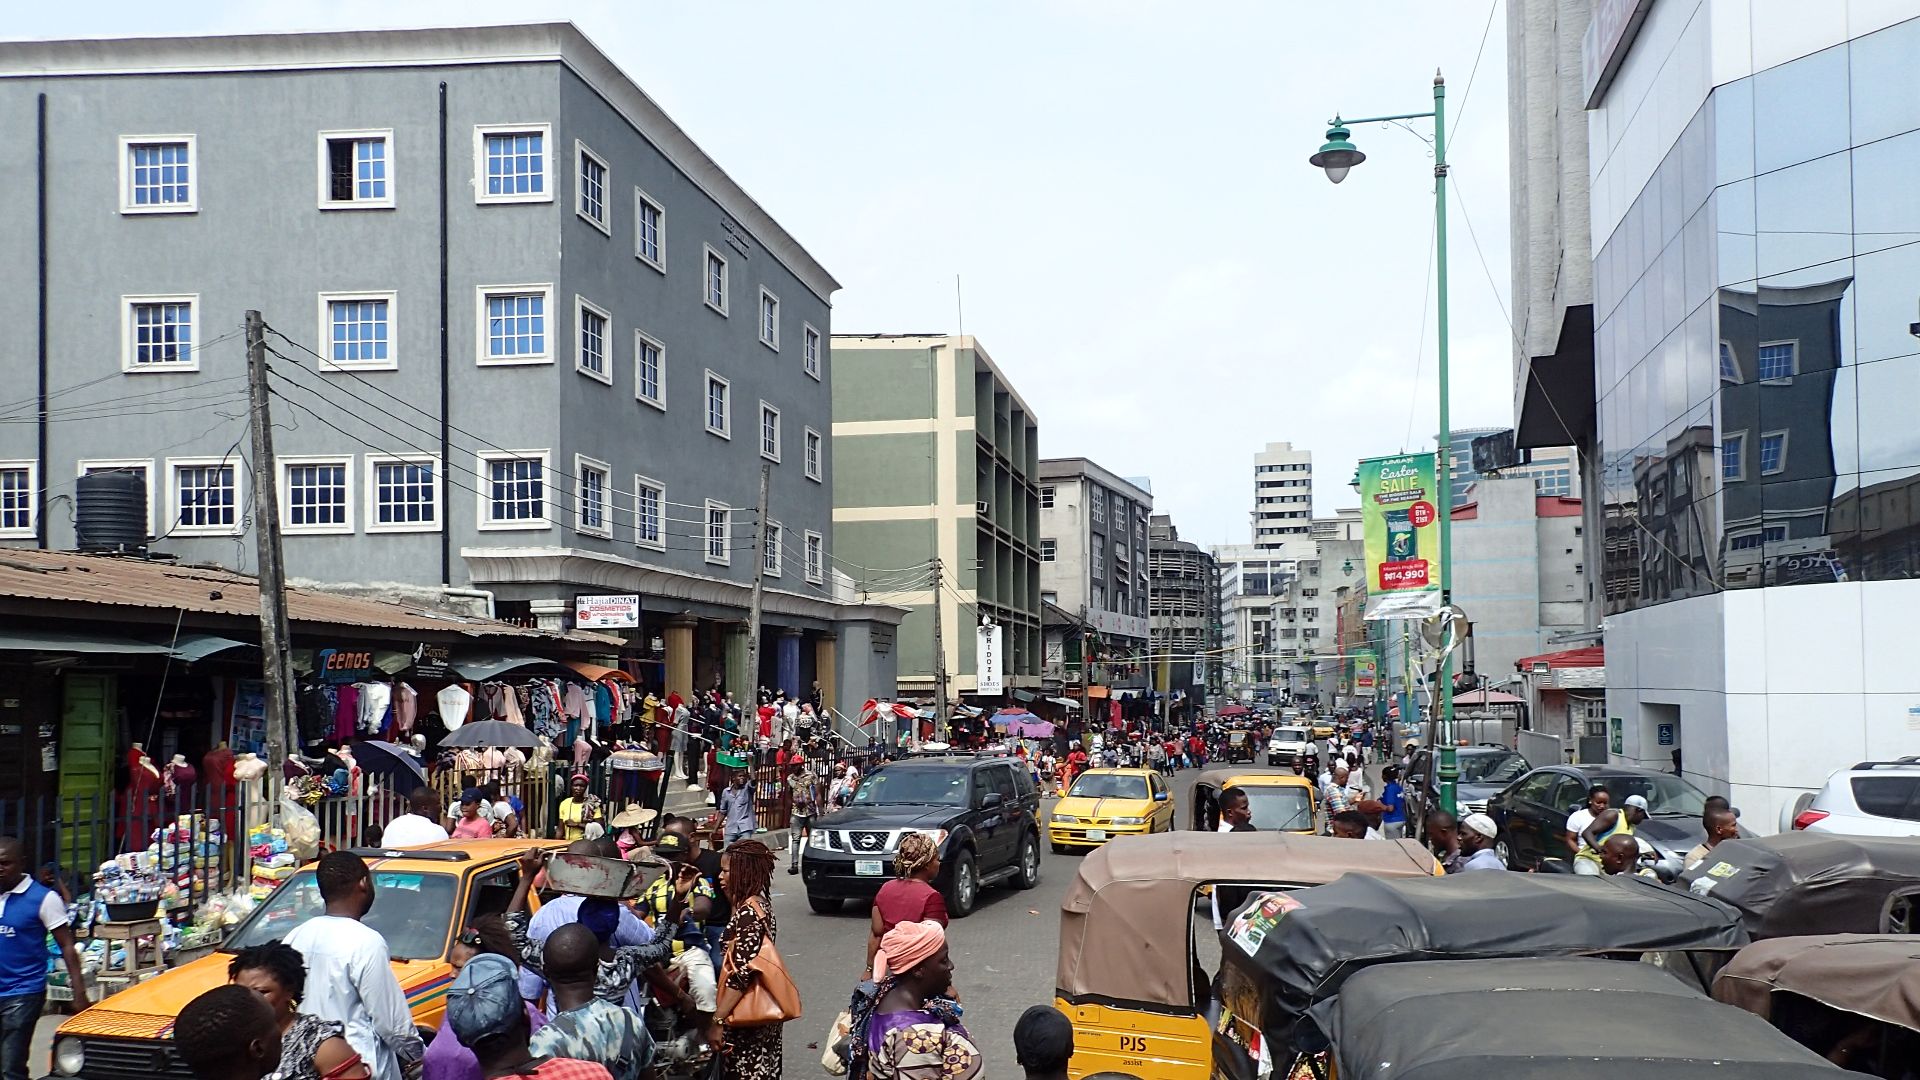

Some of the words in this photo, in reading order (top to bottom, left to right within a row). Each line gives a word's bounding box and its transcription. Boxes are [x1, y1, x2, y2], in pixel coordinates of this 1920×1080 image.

[1380, 465, 1418, 479] Easter
[1381, 476, 1418, 493] SALE
[320, 648, 371, 678] Teemos
[1121, 1037, 1146, 1051] PJS
